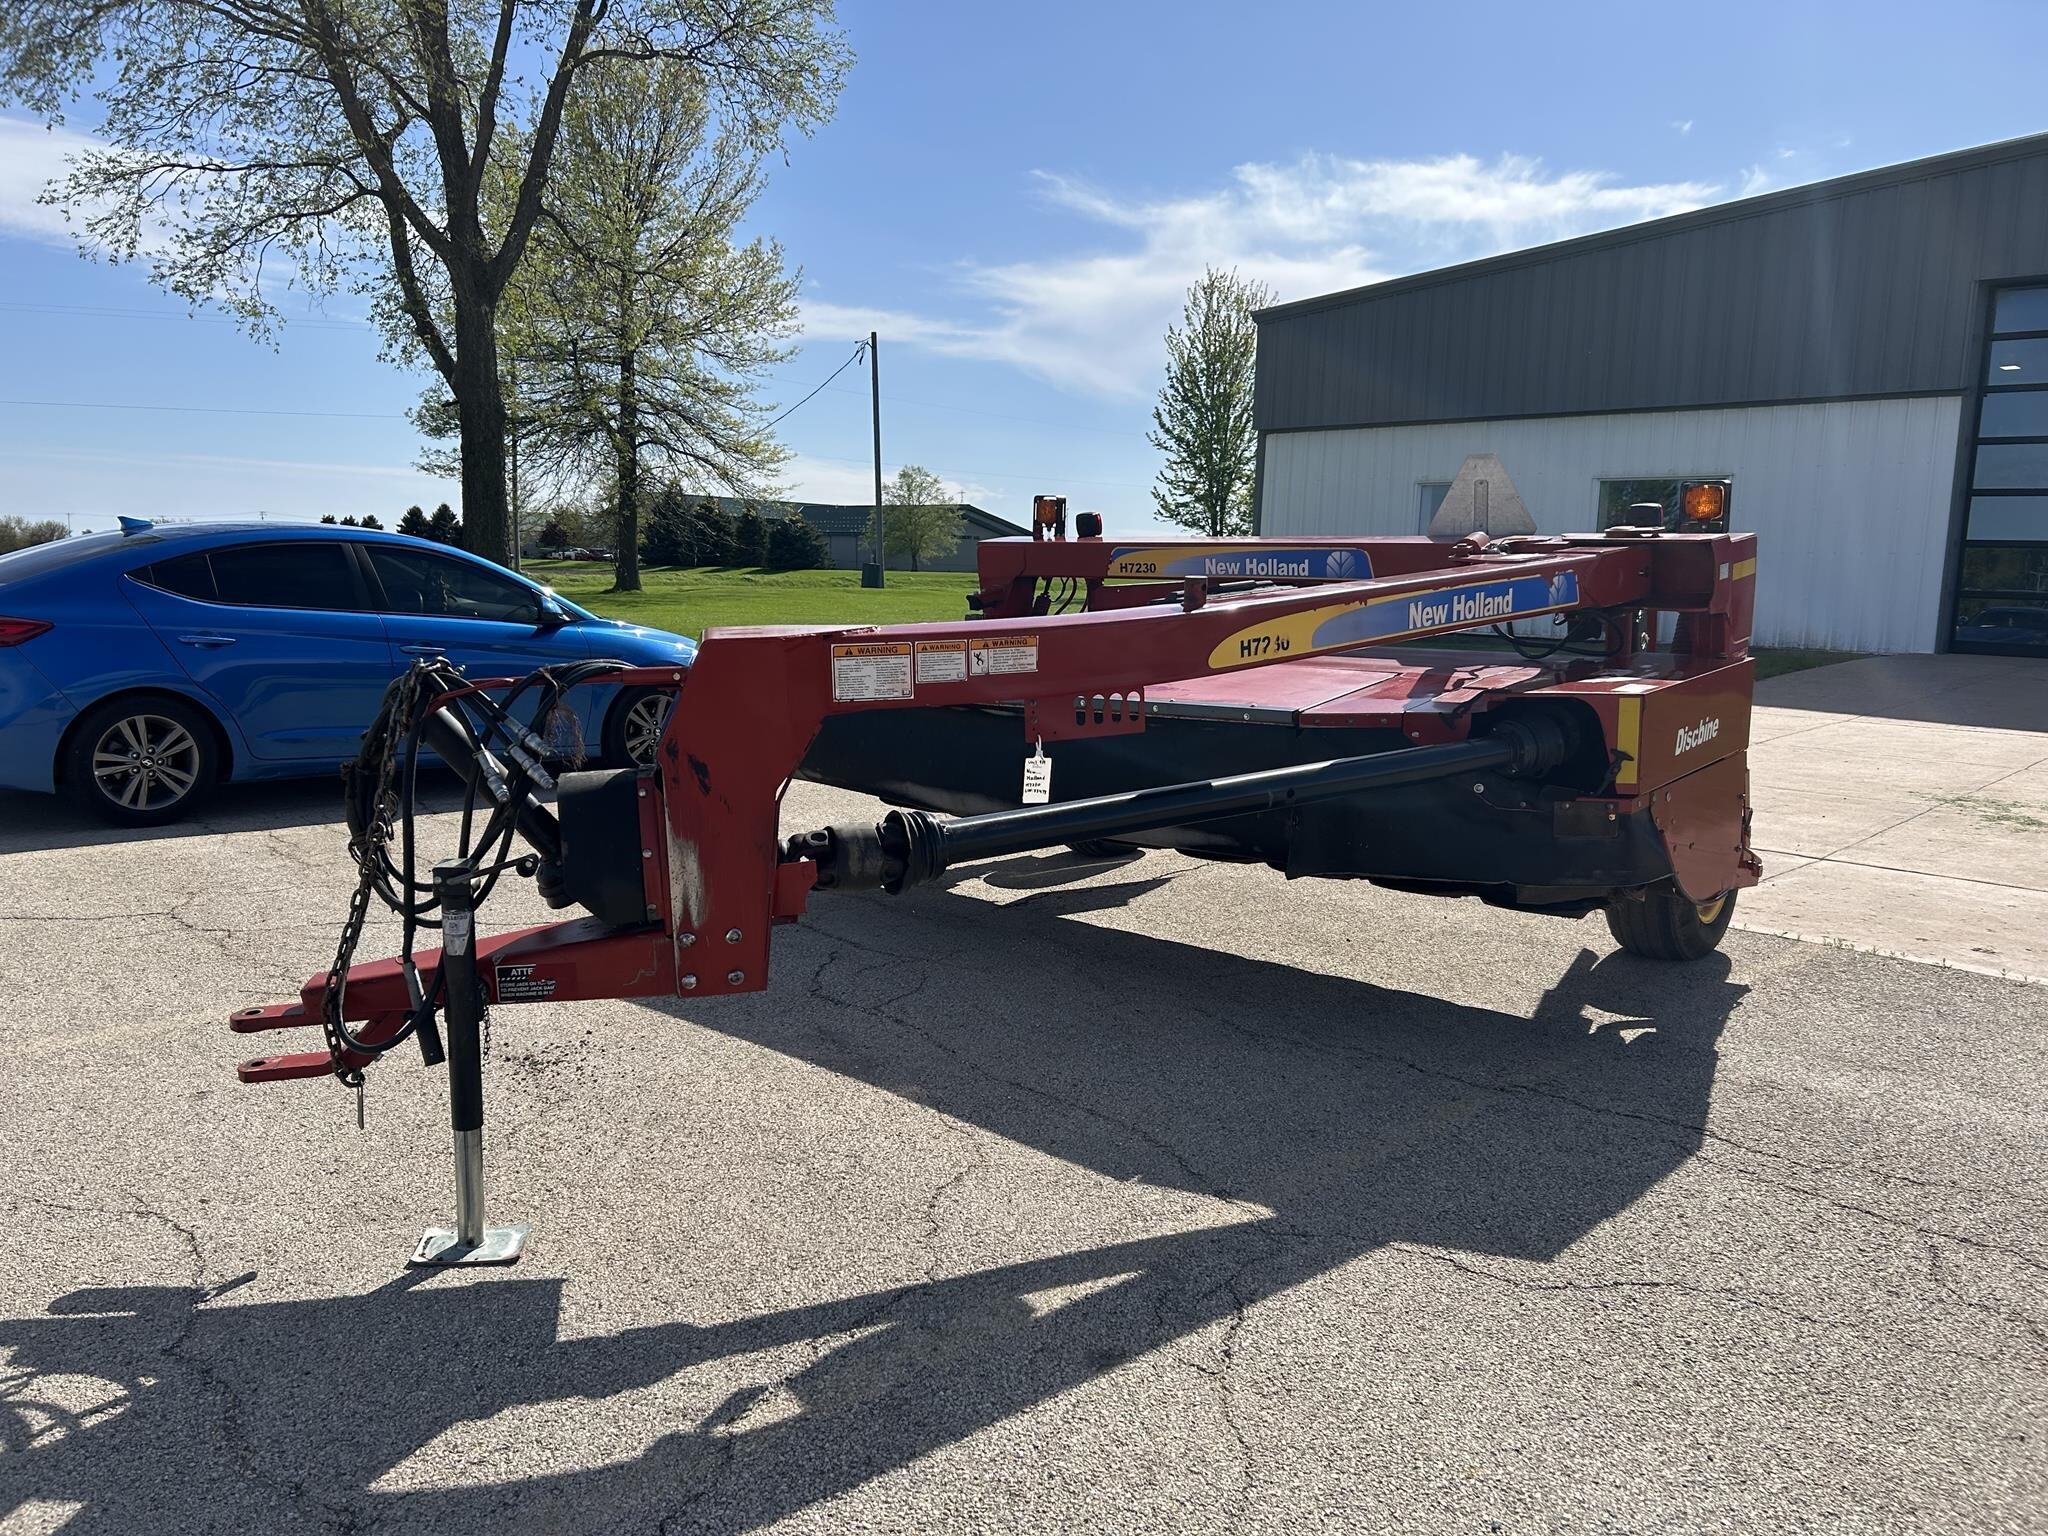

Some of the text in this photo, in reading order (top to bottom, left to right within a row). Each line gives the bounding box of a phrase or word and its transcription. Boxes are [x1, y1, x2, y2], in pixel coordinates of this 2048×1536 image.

[1119, 562, 1157, 574] H7230
[1204, 558, 1309, 577] New Holland
[1408, 588, 1513, 630] New Holland
[929, 643, 961, 651] WARNING
[992, 638, 1028, 647] WARNING
[857, 646, 899, 655] WARNING
[1674, 716, 1719, 757] Discbine
